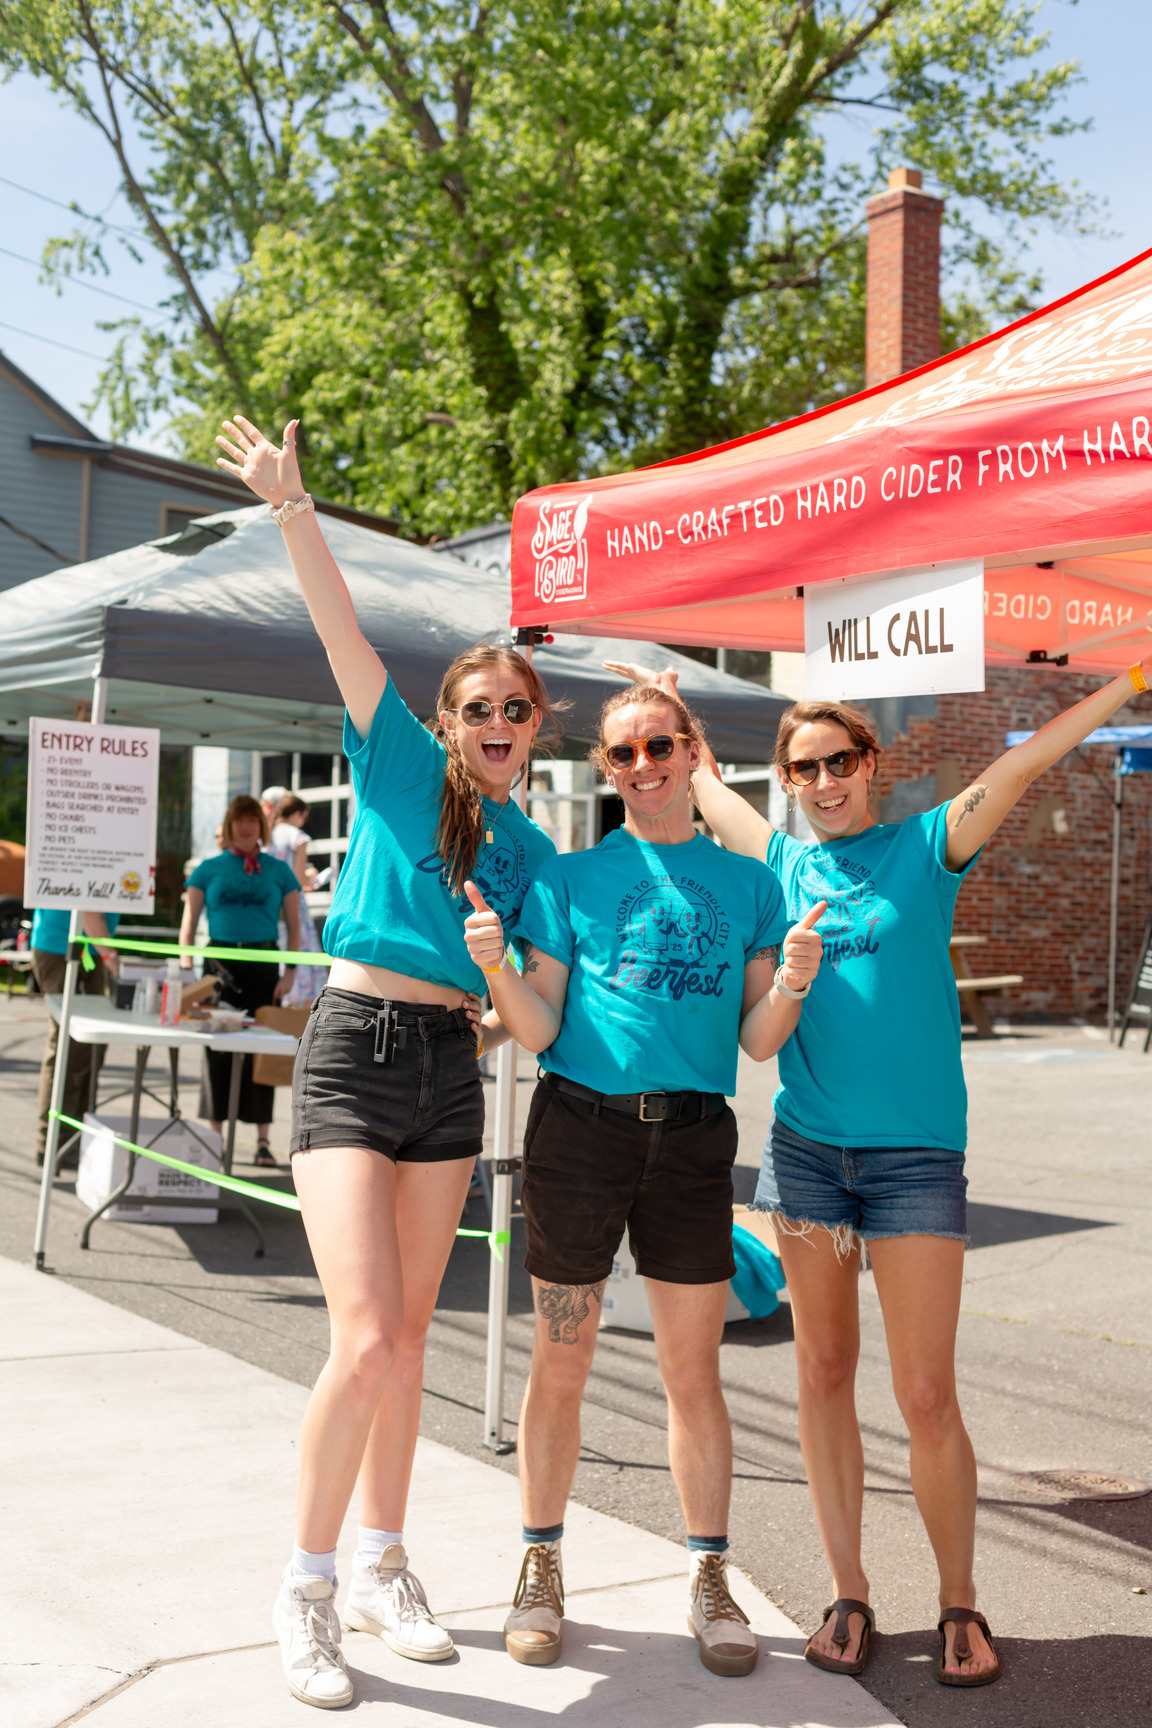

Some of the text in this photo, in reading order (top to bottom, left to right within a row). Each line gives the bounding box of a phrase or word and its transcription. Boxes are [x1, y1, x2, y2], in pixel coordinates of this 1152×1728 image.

[607, 494, 784, 557] HAND-CRAFTED
[796, 475, 866, 521] HARD
[880, 455, 963, 501] CIDER
[978, 434, 1067, 486] FROM
[827, 607, 954, 663] WILL CALL
[41, 732, 148, 758] ENTRY RULES
[60, 756, 83, 766] EVENT
[46, 767, 58, 775] NO
[46, 778, 144, 794] NO STROLLERS OR WAGONS
[46, 790, 75, 799] OUTSIDE
[46, 801, 139, 816] BAGS SEARCHED AT ENTRY
[45, 812, 85, 822] NO CHAIRS
[44, 824, 57, 832] NO
[44, 835, 76, 844] NO PETS
[37, 877, 81, 897] Thanks
[615, 875, 730, 949] WELCOME TO THE FRIENDLY CITY
[608, 950, 731, 1001] Beerfest
